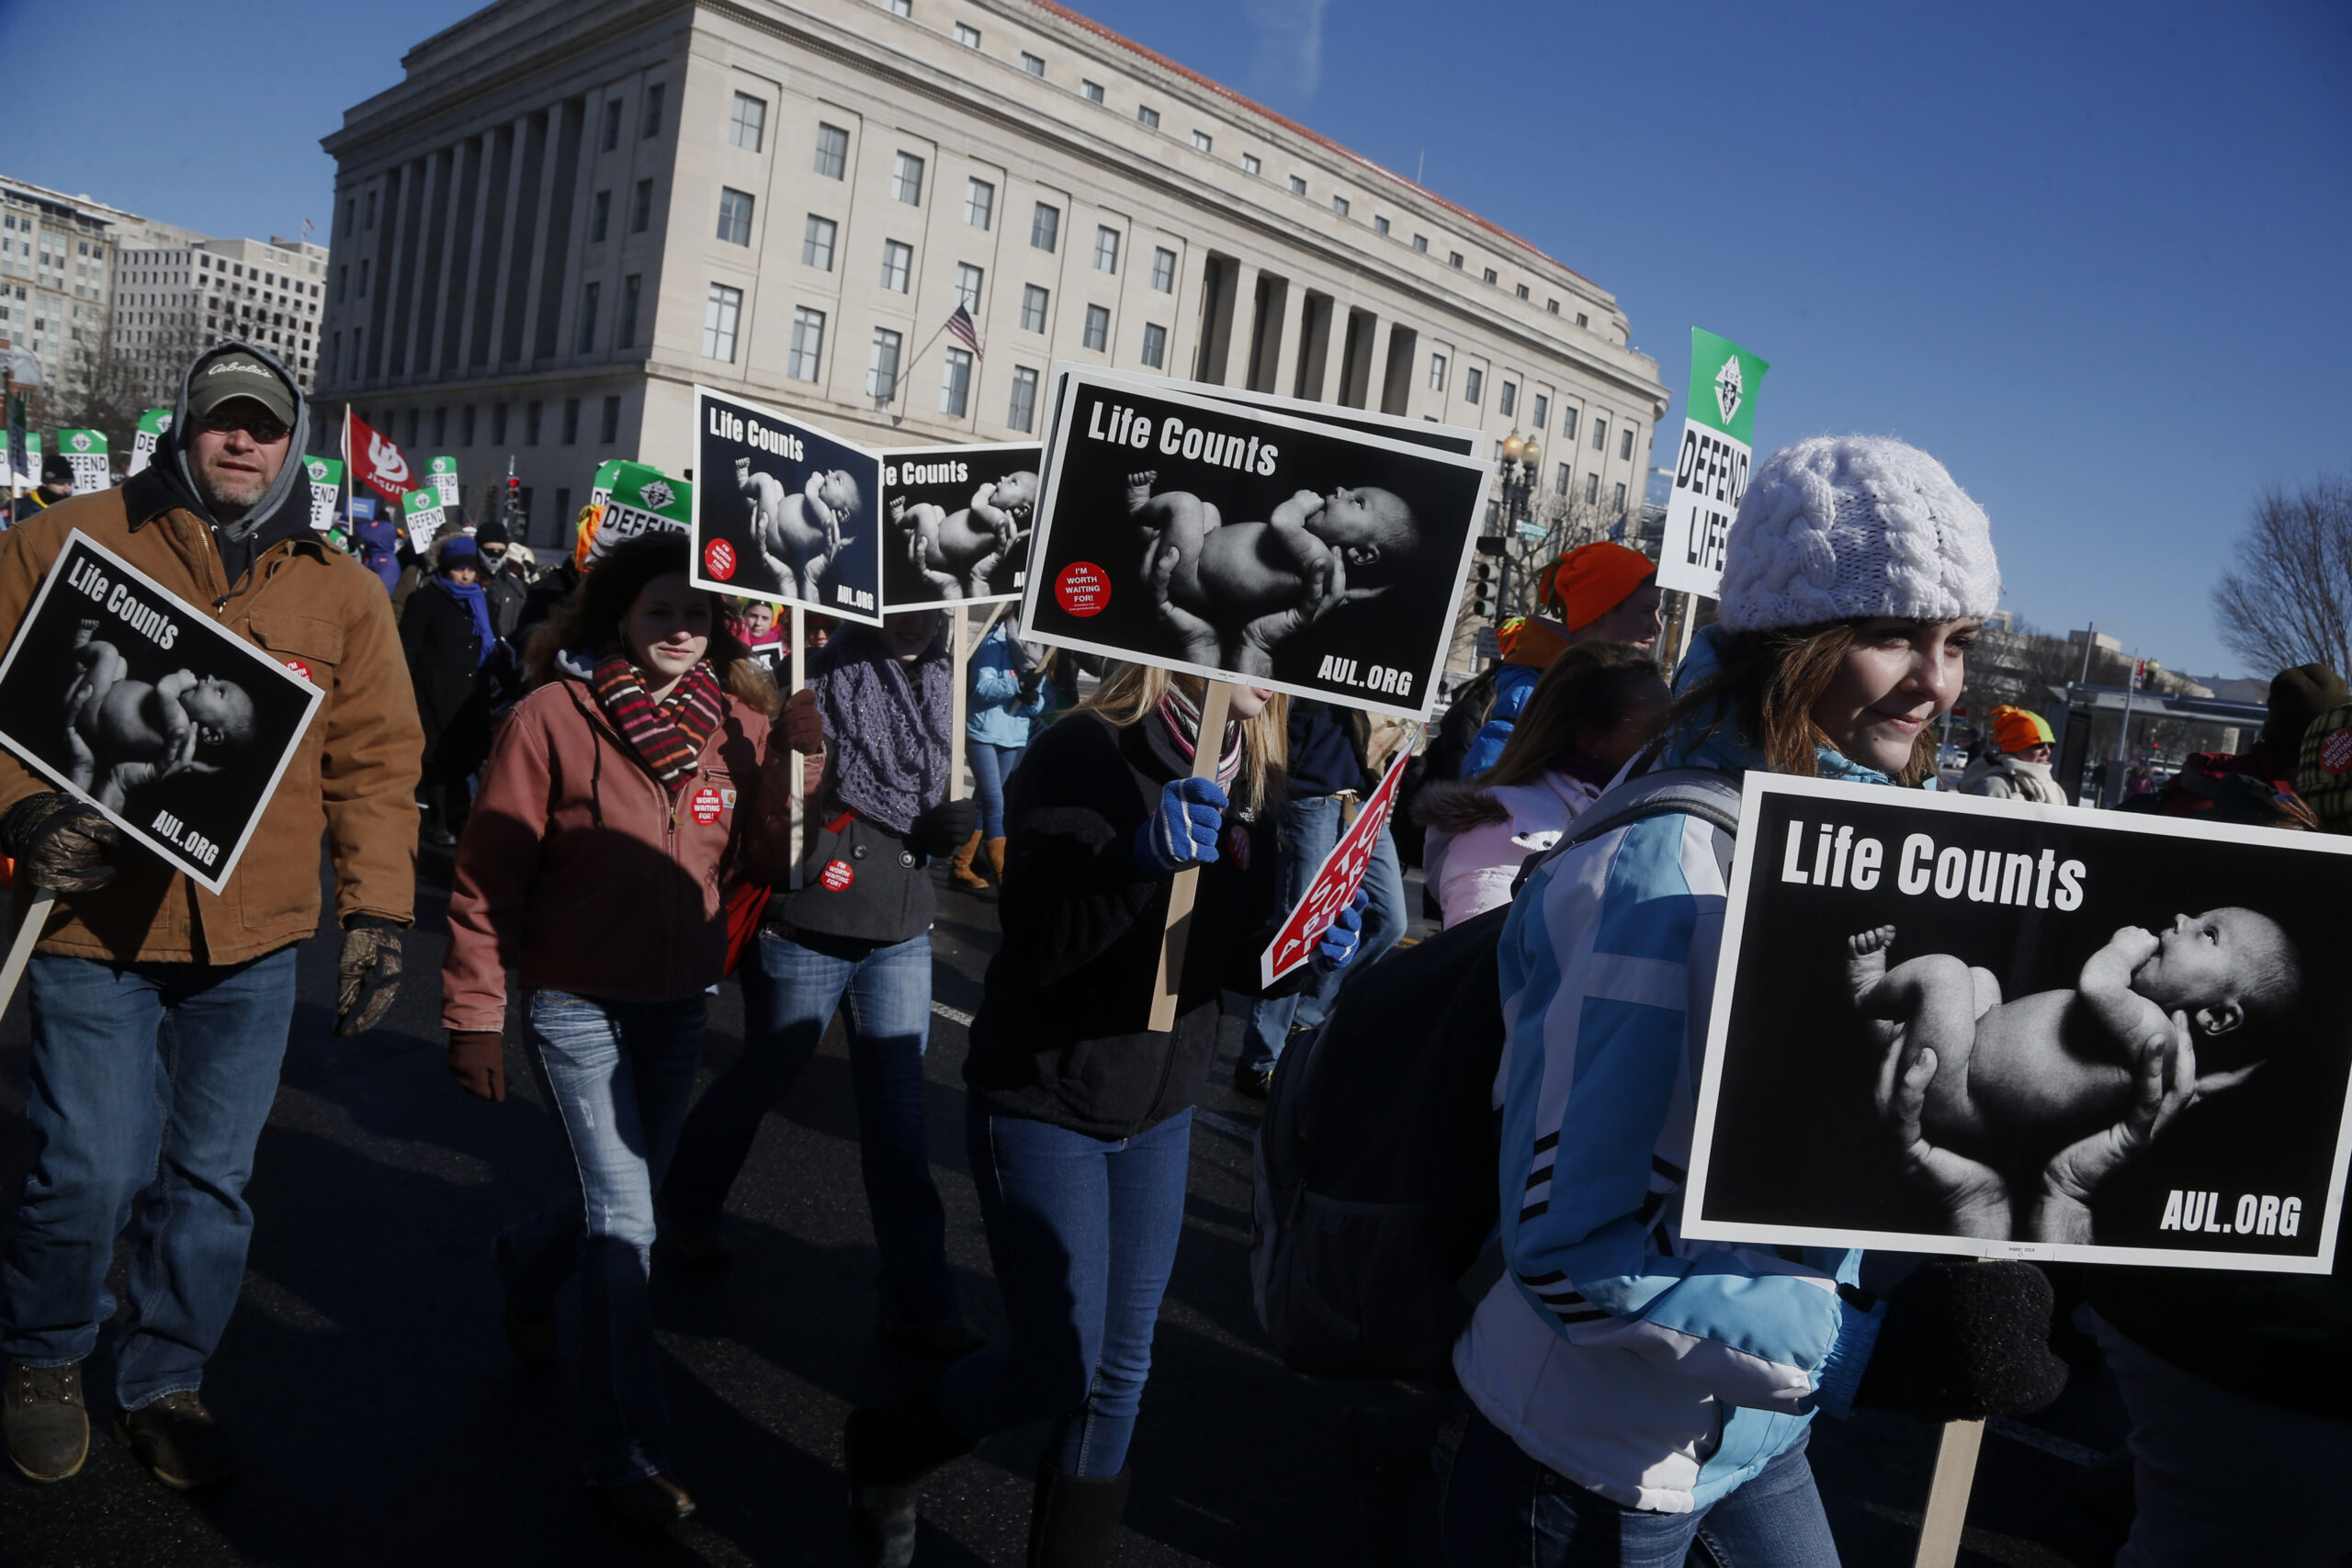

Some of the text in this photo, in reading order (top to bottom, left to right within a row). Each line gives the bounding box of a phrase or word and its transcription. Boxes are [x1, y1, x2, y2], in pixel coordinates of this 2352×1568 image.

[710, 406, 804, 462] Life Counts
[1088, 400, 1279, 476] Life Counts
[69, 456, 107, 471] EFEND
[902, 460, 968, 485] Counts
[1676, 429, 1748, 508] DEFEND
[74, 474, 97, 490] LIFE
[310, 485, 335, 503] END
[408, 509, 443, 530] DEFEND
[420, 527, 436, 544] LIF
[1687, 506, 1728, 572] LIFE
[1065, 585, 1101, 593] WAITING
[1066, 576, 1098, 584] WORTH
[67, 556, 178, 650] Life Counts
[837, 584, 874, 611] AUL.ORG
[1317, 654, 1414, 696] AUL.ORG
[2323, 731, 2350, 758] WORTH
[151, 809, 220, 867] AUL.ORG
[825, 870, 850, 885] WAITING
[829, 865, 851, 878] WORTH
[1781, 819, 2086, 912] Life Counts
[2159, 1190, 2303, 1237] AUL.ORG
